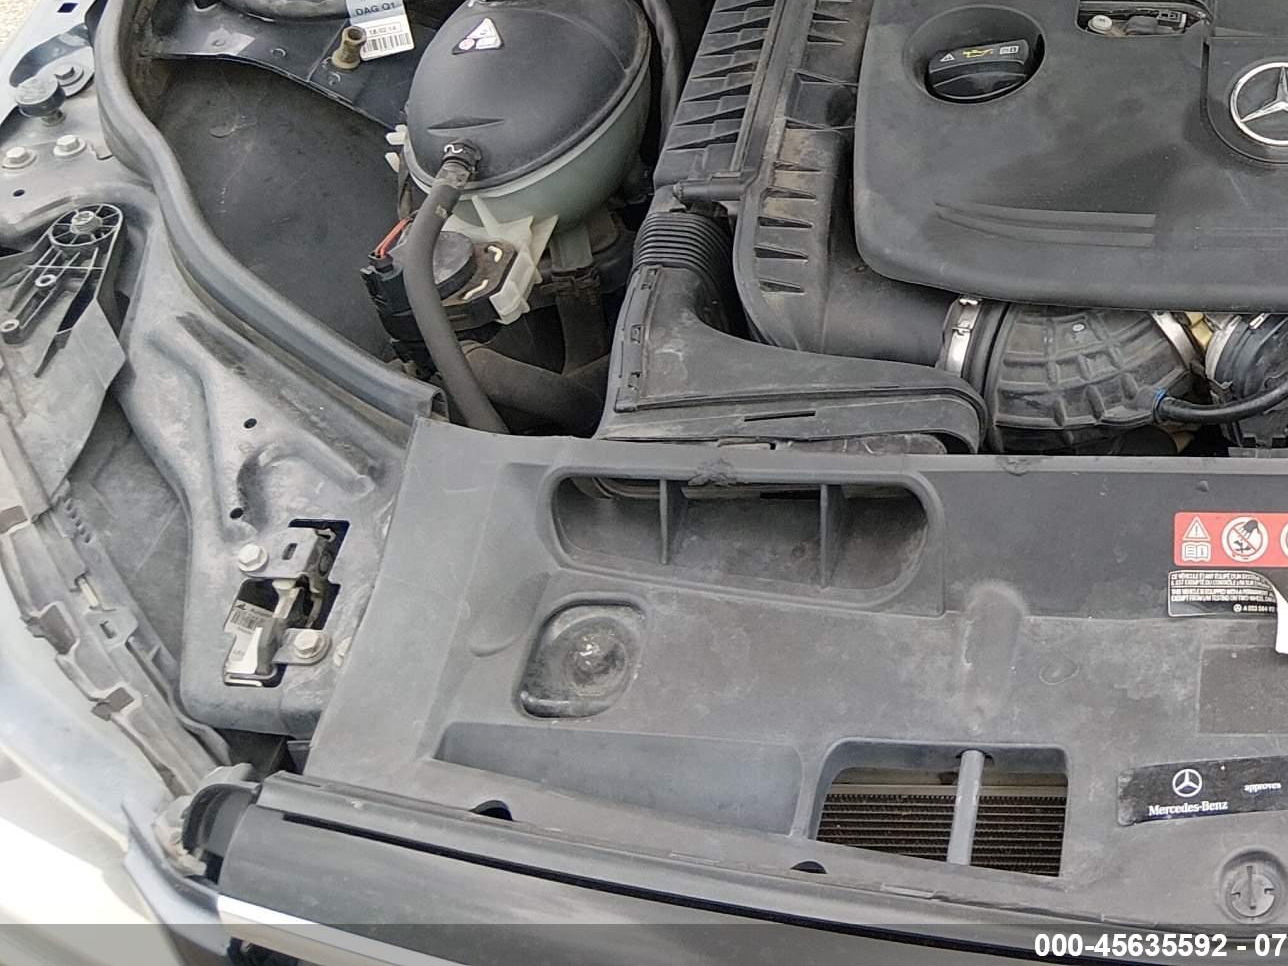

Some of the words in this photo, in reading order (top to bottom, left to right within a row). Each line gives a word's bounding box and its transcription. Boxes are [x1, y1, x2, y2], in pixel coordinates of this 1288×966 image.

[355, 5, 380, 16] DAG
[1244, 782, 1282, 794] approves
[1148, 800, 1228, 817] Mercedes-Benz
